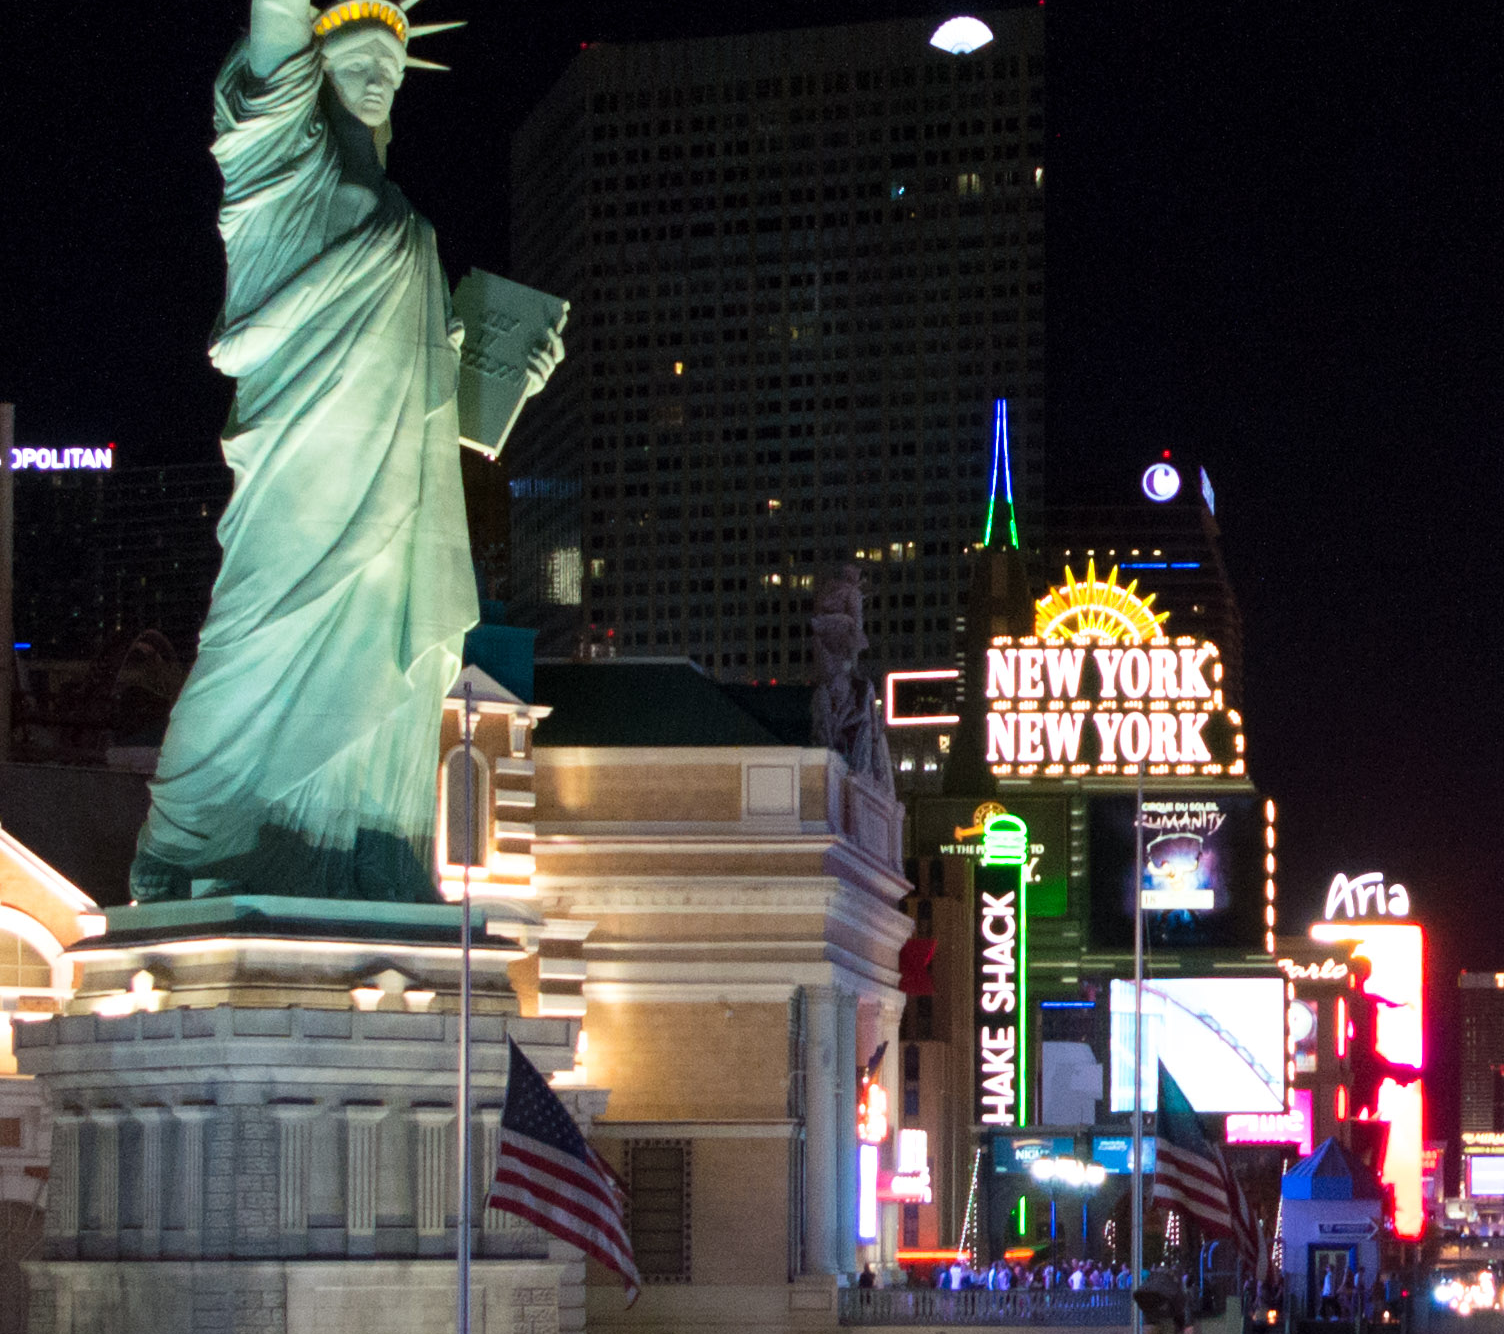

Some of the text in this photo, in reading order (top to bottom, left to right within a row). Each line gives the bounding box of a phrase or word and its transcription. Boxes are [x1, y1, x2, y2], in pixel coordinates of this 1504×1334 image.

[986, 648, 1211, 699] NEW YORK
[986, 712, 1211, 762] NEW YORK
[1142, 802, 1219, 814] CIRQUE DU SOLEIL
[940, 844, 954, 854] WE
[956, 844, 976, 854] THE
[1325, 872, 1409, 920] Aria
[982, 890, 1015, 1013] SHACK
[982, 1025, 1015, 1126] HAKE
